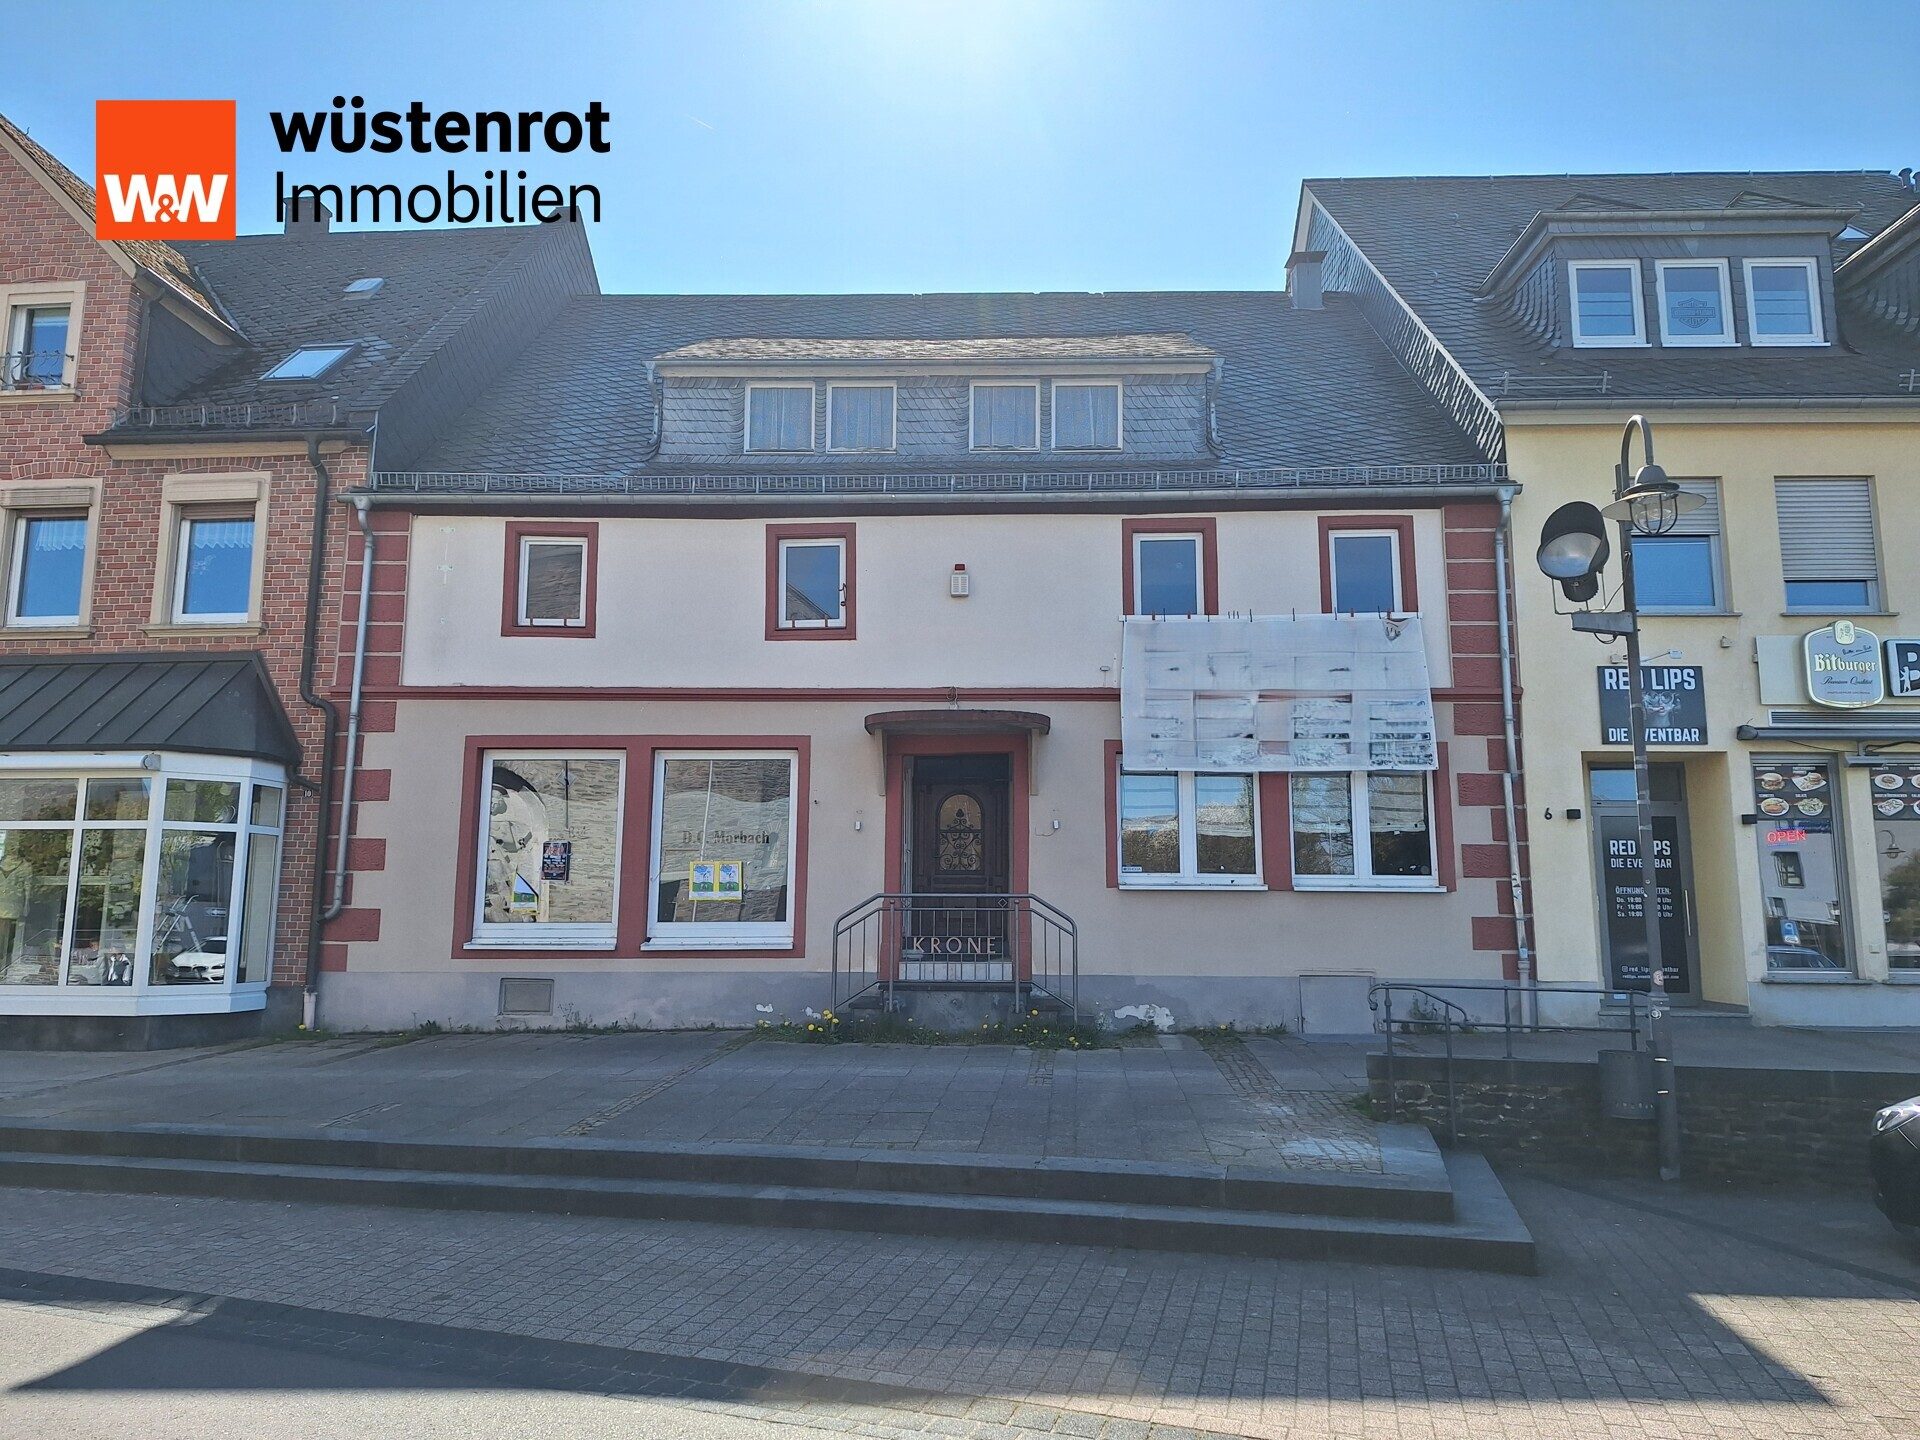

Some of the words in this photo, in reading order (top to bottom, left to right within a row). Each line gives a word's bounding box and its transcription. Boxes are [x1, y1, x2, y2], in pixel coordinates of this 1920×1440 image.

[1814, 653, 1877, 674] Bitburger
[1604, 668, 1644, 690] RE
[1651, 668, 1696, 690] LIPS
[1608, 728, 1629, 742] DIE
[1645, 728, 1700, 742] ENTBAR
[1544, 807, 1552, 820] 6
[1766, 829, 1807, 843] OPEN
[1609, 840, 1636, 855] RED
[1610, 858, 1624, 868] DIE
[1627, 858, 1672, 868] EVEBAR
[913, 937, 996, 954] KRONE
